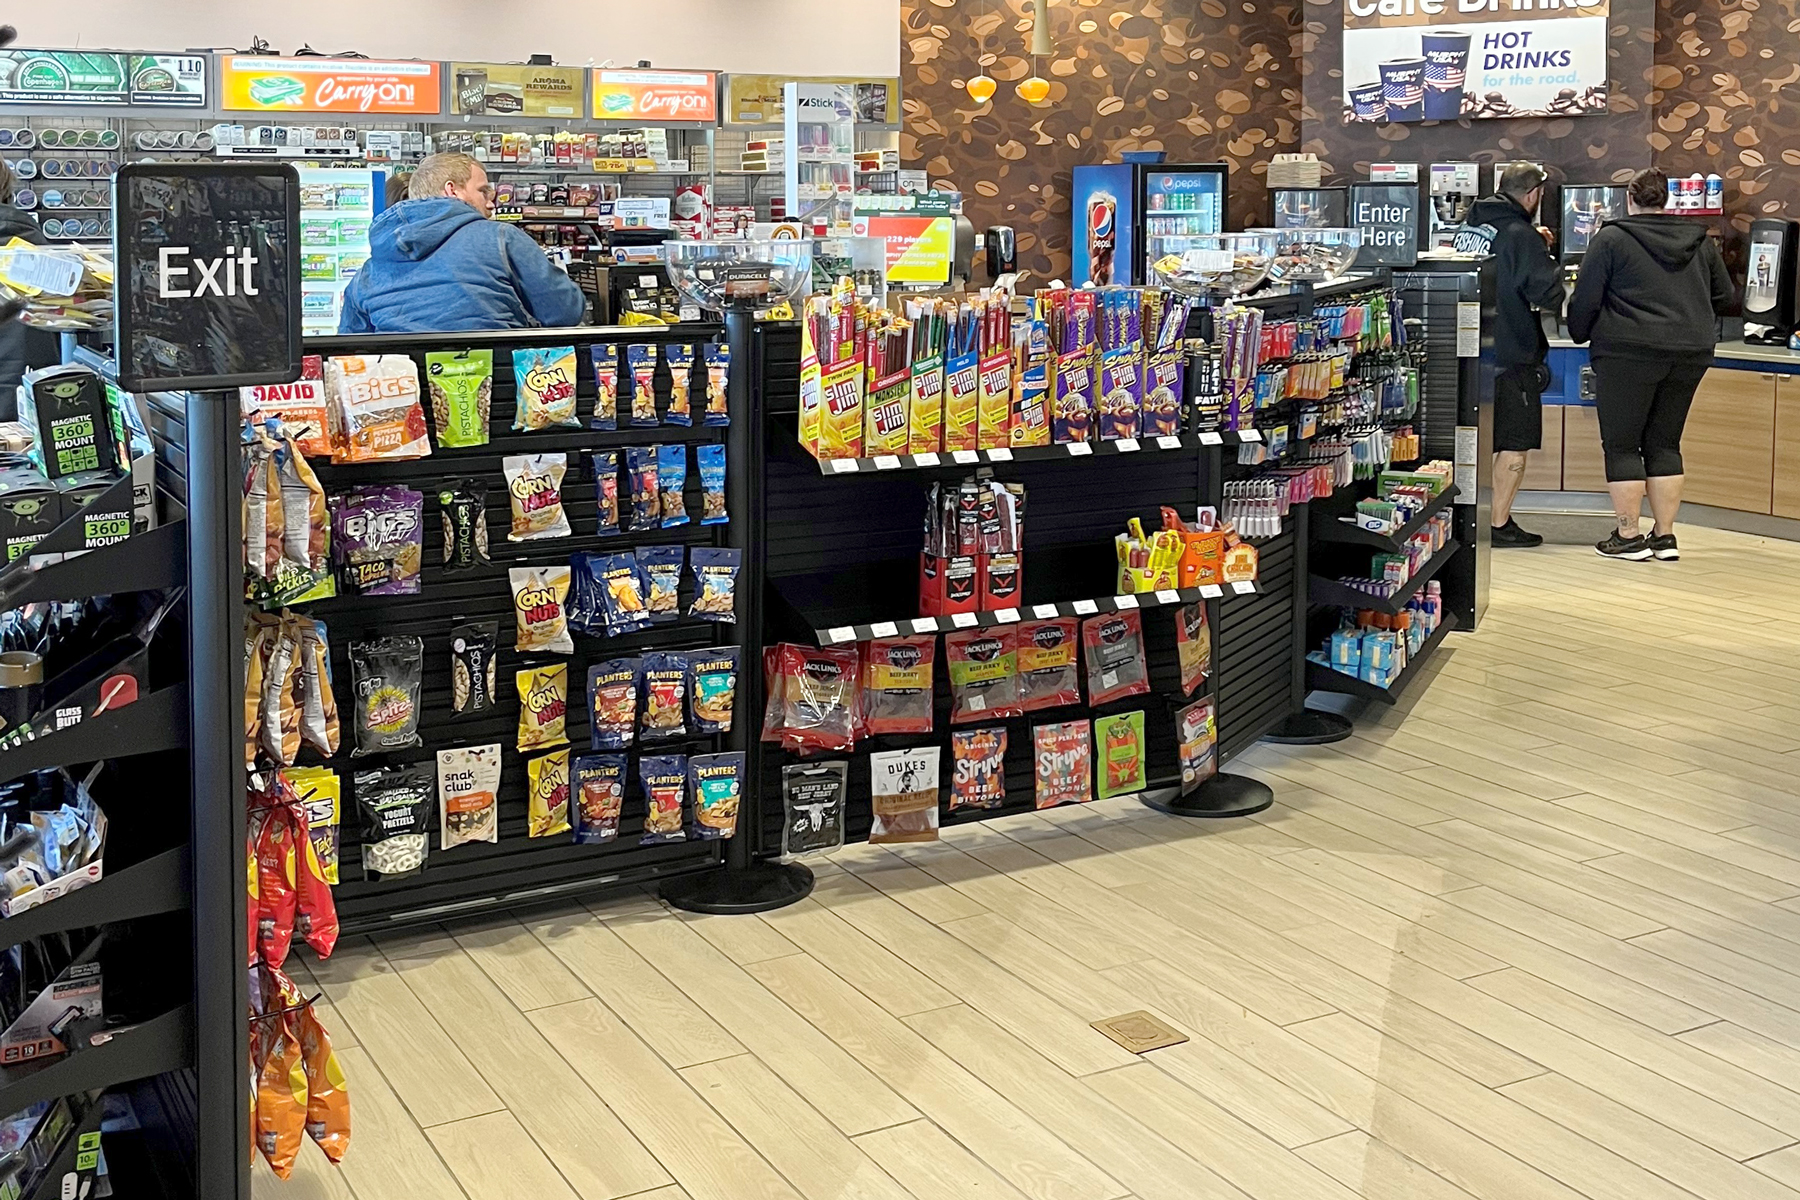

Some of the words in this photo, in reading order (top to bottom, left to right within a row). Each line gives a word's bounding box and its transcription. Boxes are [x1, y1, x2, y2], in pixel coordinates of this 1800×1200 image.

[1483, 31, 1532, 49] HOT
[1427, 50, 1466, 60] MURPHY
[1483, 50, 1571, 71] DRINKS
[1385, 68, 1422, 79] MURPHY
[1391, 75, 1409, 83] USA
[1483, 75, 1505, 87] for
[1509, 74, 1534, 86] the
[1538, 71, 1581, 84] road.
[24, 76, 64, 87] Copenhagen
[525, 83, 573, 91] REWARDS
[532, 77, 567, 85] AROMA
[315, 77, 377, 111] Carry
[639, 91, 682, 115] Carry
[810, 97, 834, 108] Stick
[1358, 202, 1411, 223] Enter
[1360, 226, 1406, 246] Here
[1453, 231, 1492, 255] FISHING
[158, 246, 259, 299] Exit
[829, 358, 857, 372] ORIGINAL
[983, 355, 1009, 369] ORIGINAL
[526, 368, 569, 392] CORN
[827, 372, 842, 382] TWIN
[841, 367, 858, 378] PACK
[877, 372, 905, 388] ORIGINAL
[253, 384, 315, 402] DAVID
[538, 381, 576, 405] NUTS
[874, 382, 906, 403] MONSTER
[51, 414, 92, 427] MAGNETIC
[54, 435, 95, 450] MOUNT
[373, 432, 402, 449] PIZZA
[511, 475, 552, 499] CORN
[522, 487, 561, 513] NUTS
[84, 511, 130, 522] MAGNETIC
[7, 533, 50, 545] MAGNETI
[359, 561, 385, 577] TACO
[648, 563, 677, 573] PLANTERS
[702, 565, 733, 574] PLANTERS
[516, 586, 555, 611] CORN
[524, 603, 561, 625] NUTS
[1032, 631, 1047, 641] JACK
[1098, 628, 1112, 638] JACK
[887, 650, 901, 659] JACK
[964, 645, 981, 655] JACK
[1048, 650, 1064, 658] JERKY
[696, 660, 733, 673] PLANTERS
[802, 662, 820, 672] JACK
[982, 662, 1000, 671] JERKY
[470, 650, 485, 709] PISTACHIOS
[596, 671, 633, 687] PLANTERS
[647, 670, 684, 681] PLANTERS
[527, 686, 559, 713] CORN
[56, 706, 82, 717] GLASS
[366, 700, 414, 730] Spitz
[537, 702, 566, 726] NUTS
[56, 715, 82, 728] BUTT
[965, 741, 998, 750] ORIGINAL
[1040, 743, 1089, 777] Stryve
[445, 769, 475, 782] snak
[579, 767, 619, 780] PLANTERS
[697, 765, 737, 778] PLANTERS
[445, 780, 472, 792] club
[538, 770, 560, 798] CORN
[647, 775, 684, 786] PLANTERS
[1053, 776, 1078, 786] BEEF
[812, 790, 832, 798] JERKY
[968, 784, 993, 794] BEEF
[1043, 785, 1087, 797] BILTONG
[547, 784, 570, 811] NUTS
[384, 805, 412, 820] YOGURT
[383, 815, 415, 830] PRETZELS
[24, 1046, 34, 1054] 10
